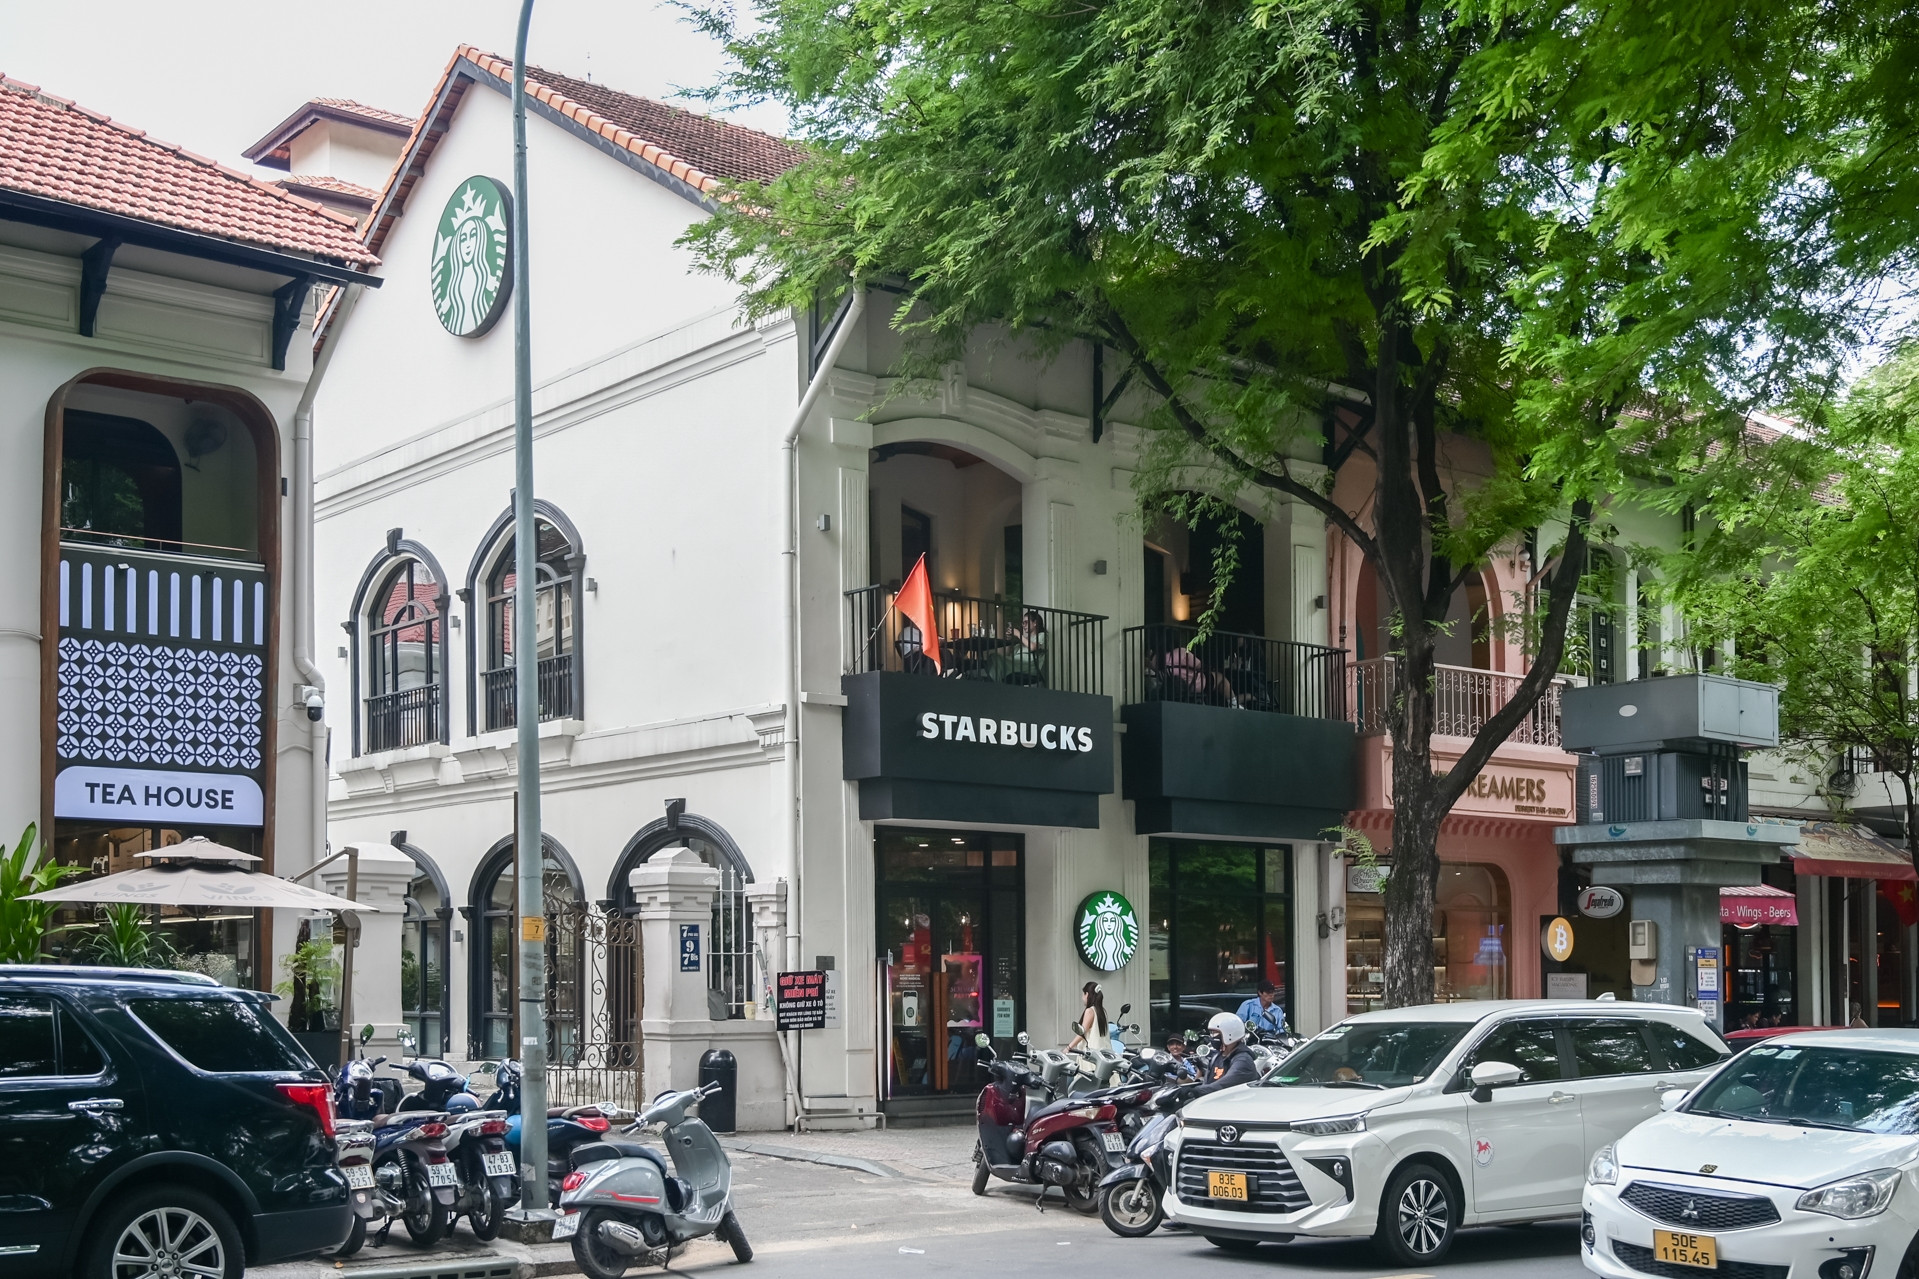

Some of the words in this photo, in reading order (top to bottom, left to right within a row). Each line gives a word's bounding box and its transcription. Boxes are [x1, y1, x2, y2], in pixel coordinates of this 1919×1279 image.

[921, 712, 1093, 752] STARBUCKS
[1468, 774, 1546, 803] REAMERS
[85, 782, 137, 805] TEA
[145, 785, 234, 810] HOUSE
[1736, 906, 1762, 920] Wings
[1769, 906, 1791, 918] Beers
[534, 926, 540, 934] 7
[681, 926, 689, 937] 7
[686, 940, 695, 952] 9
[682, 953, 690, 965] 7
[794, 976, 805, 985] XE
[806, 973, 823, 984] MÁY
[806, 986, 818, 997] PHÍ
[489, 1155, 509, 1164] 47-B3
[346, 1167, 368, 1177] 59-S3
[1219, 1174, 1235, 1185] 83E
[1213, 1186, 1243, 1198] 006.03
[1671, 1234, 1698, 1249] 50E
[1663, 1247, 1710, 1265] 115.45
